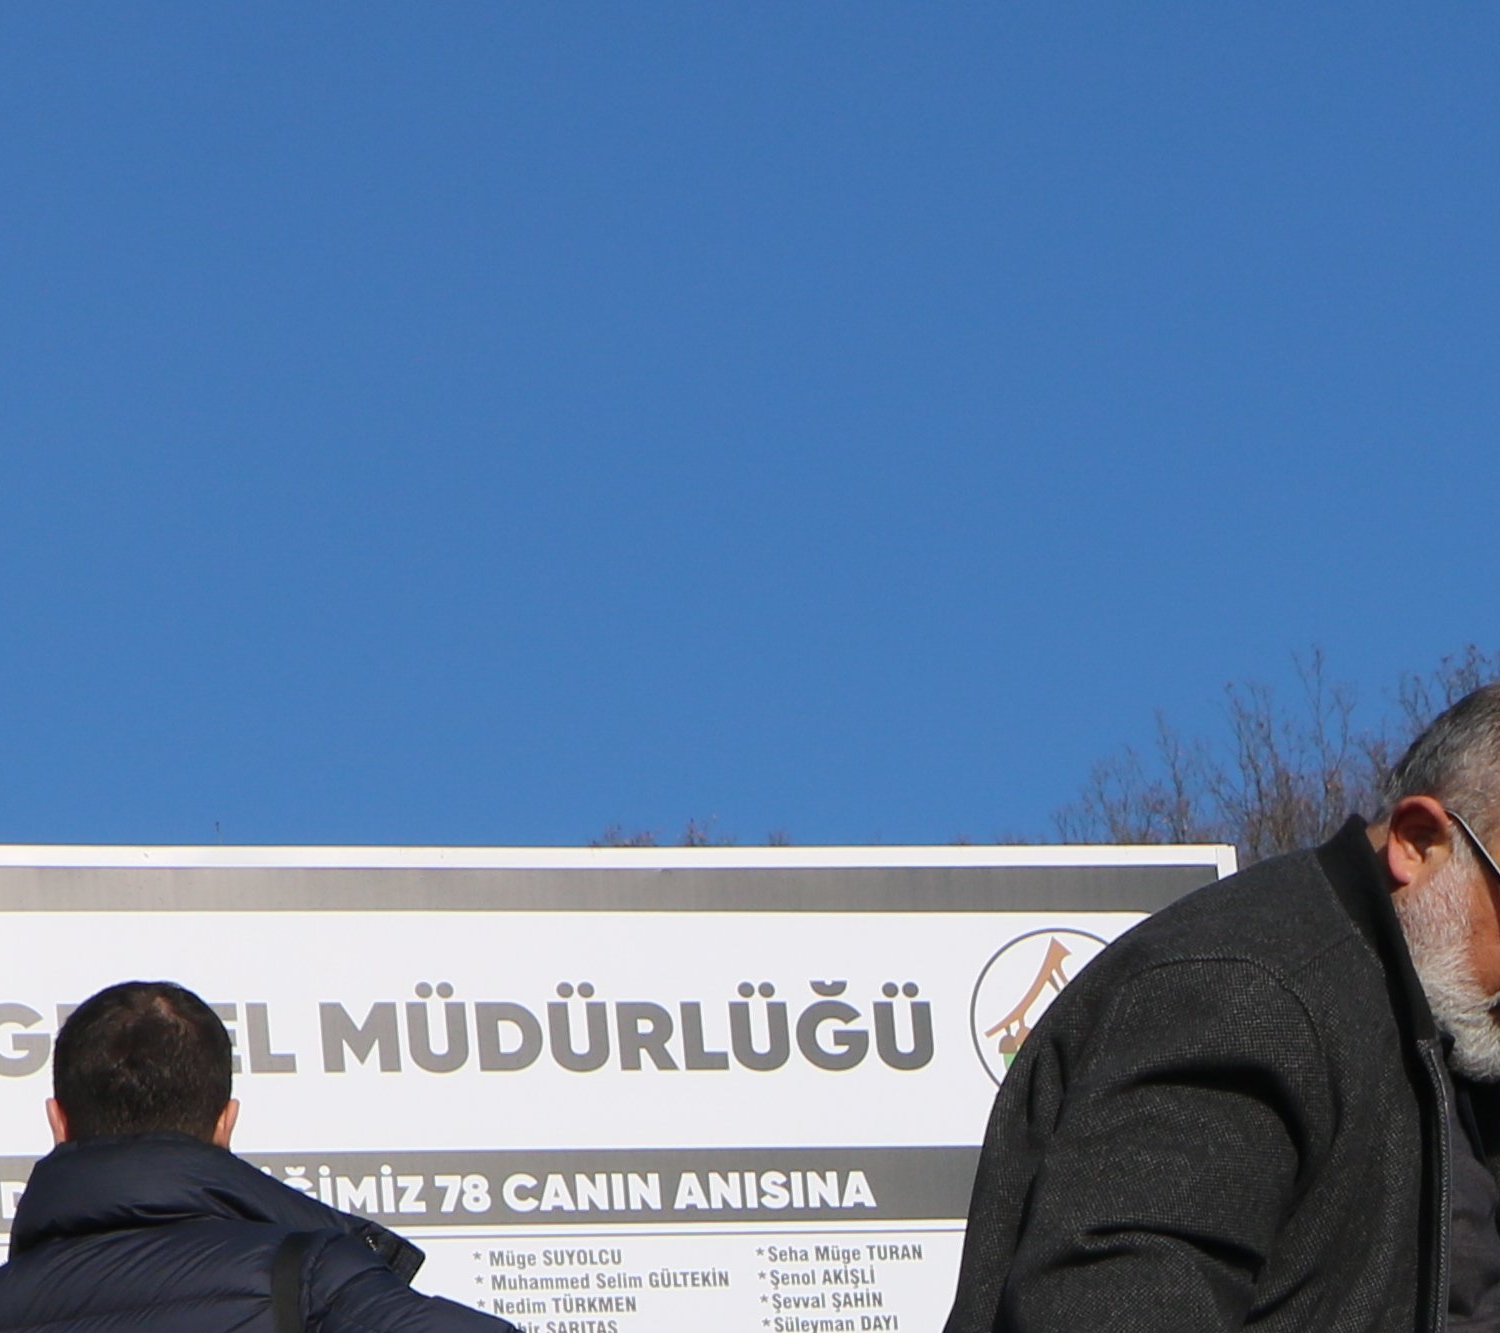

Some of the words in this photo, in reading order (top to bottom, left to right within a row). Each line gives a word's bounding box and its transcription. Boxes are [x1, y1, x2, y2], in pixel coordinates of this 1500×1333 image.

[320, 980, 934, 1073] MÜDÜRLÜĞÜ
[435, 1175, 492, 1211] 78
[503, 1173, 662, 1212] CANIN
[675, 1171, 876, 1211] ANISINA
[489, 1251, 536, 1270] Müge
[543, 1249, 622, 1265] SUYOLCU
[768, 1246, 809, 1263] Seha
[815, 1245, 861, 1264] Müge
[866, 1244, 923, 1260] TURAN
[491, 1273, 590, 1291] Muhammed
[596, 1272, 642, 1289] Selim
[649, 1268, 729, 1288] GÜLTEKİN
[770, 1269, 816, 1289] Şenol
[822, 1264, 875, 1289] AKİŞLİ
[493, 1298, 546, 1315] Nedim
[552, 1294, 637, 1313] TÜRKMEN
[772, 1292, 825, 1313] Şevval
[832, 1288, 883, 1313] ŞAHİN
[861, 1315, 898, 1331] DAYI
